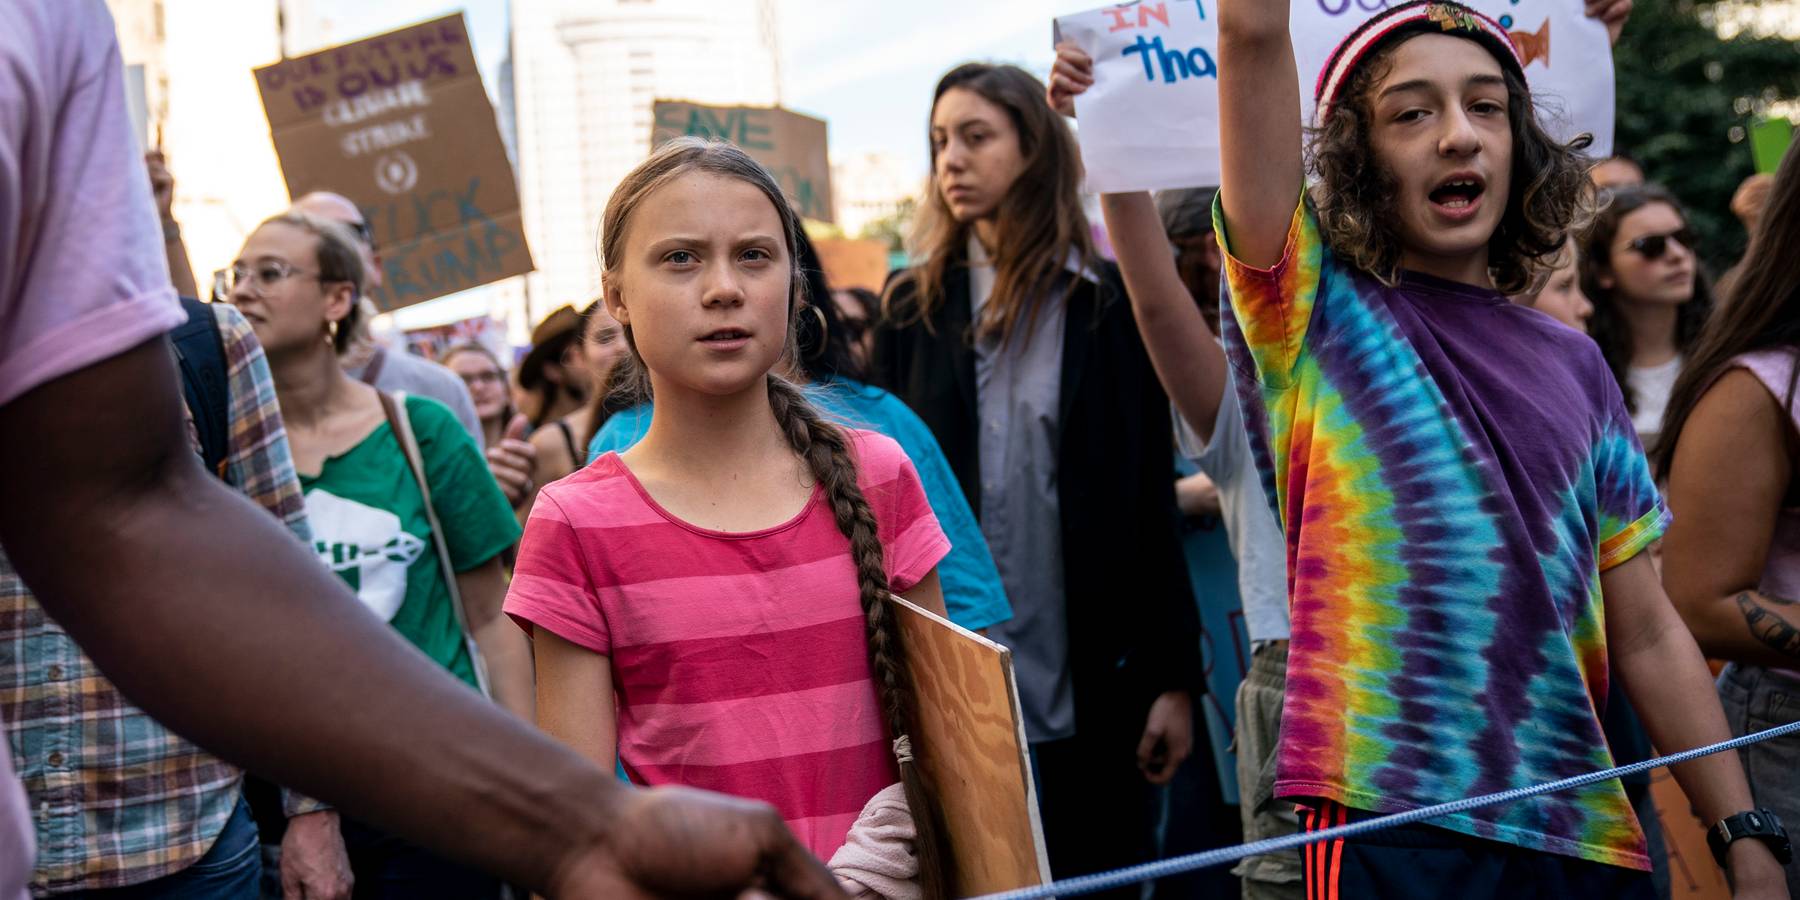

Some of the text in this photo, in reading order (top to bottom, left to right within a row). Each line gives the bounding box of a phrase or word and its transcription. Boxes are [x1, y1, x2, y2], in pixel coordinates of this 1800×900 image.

[1102, 3, 1170, 32] IN
[337, 62, 401, 97] ON
[321, 80, 433, 127] CLIMATE
[340, 113, 433, 156] STRIKE
[653, 104, 774, 150] SAVE
